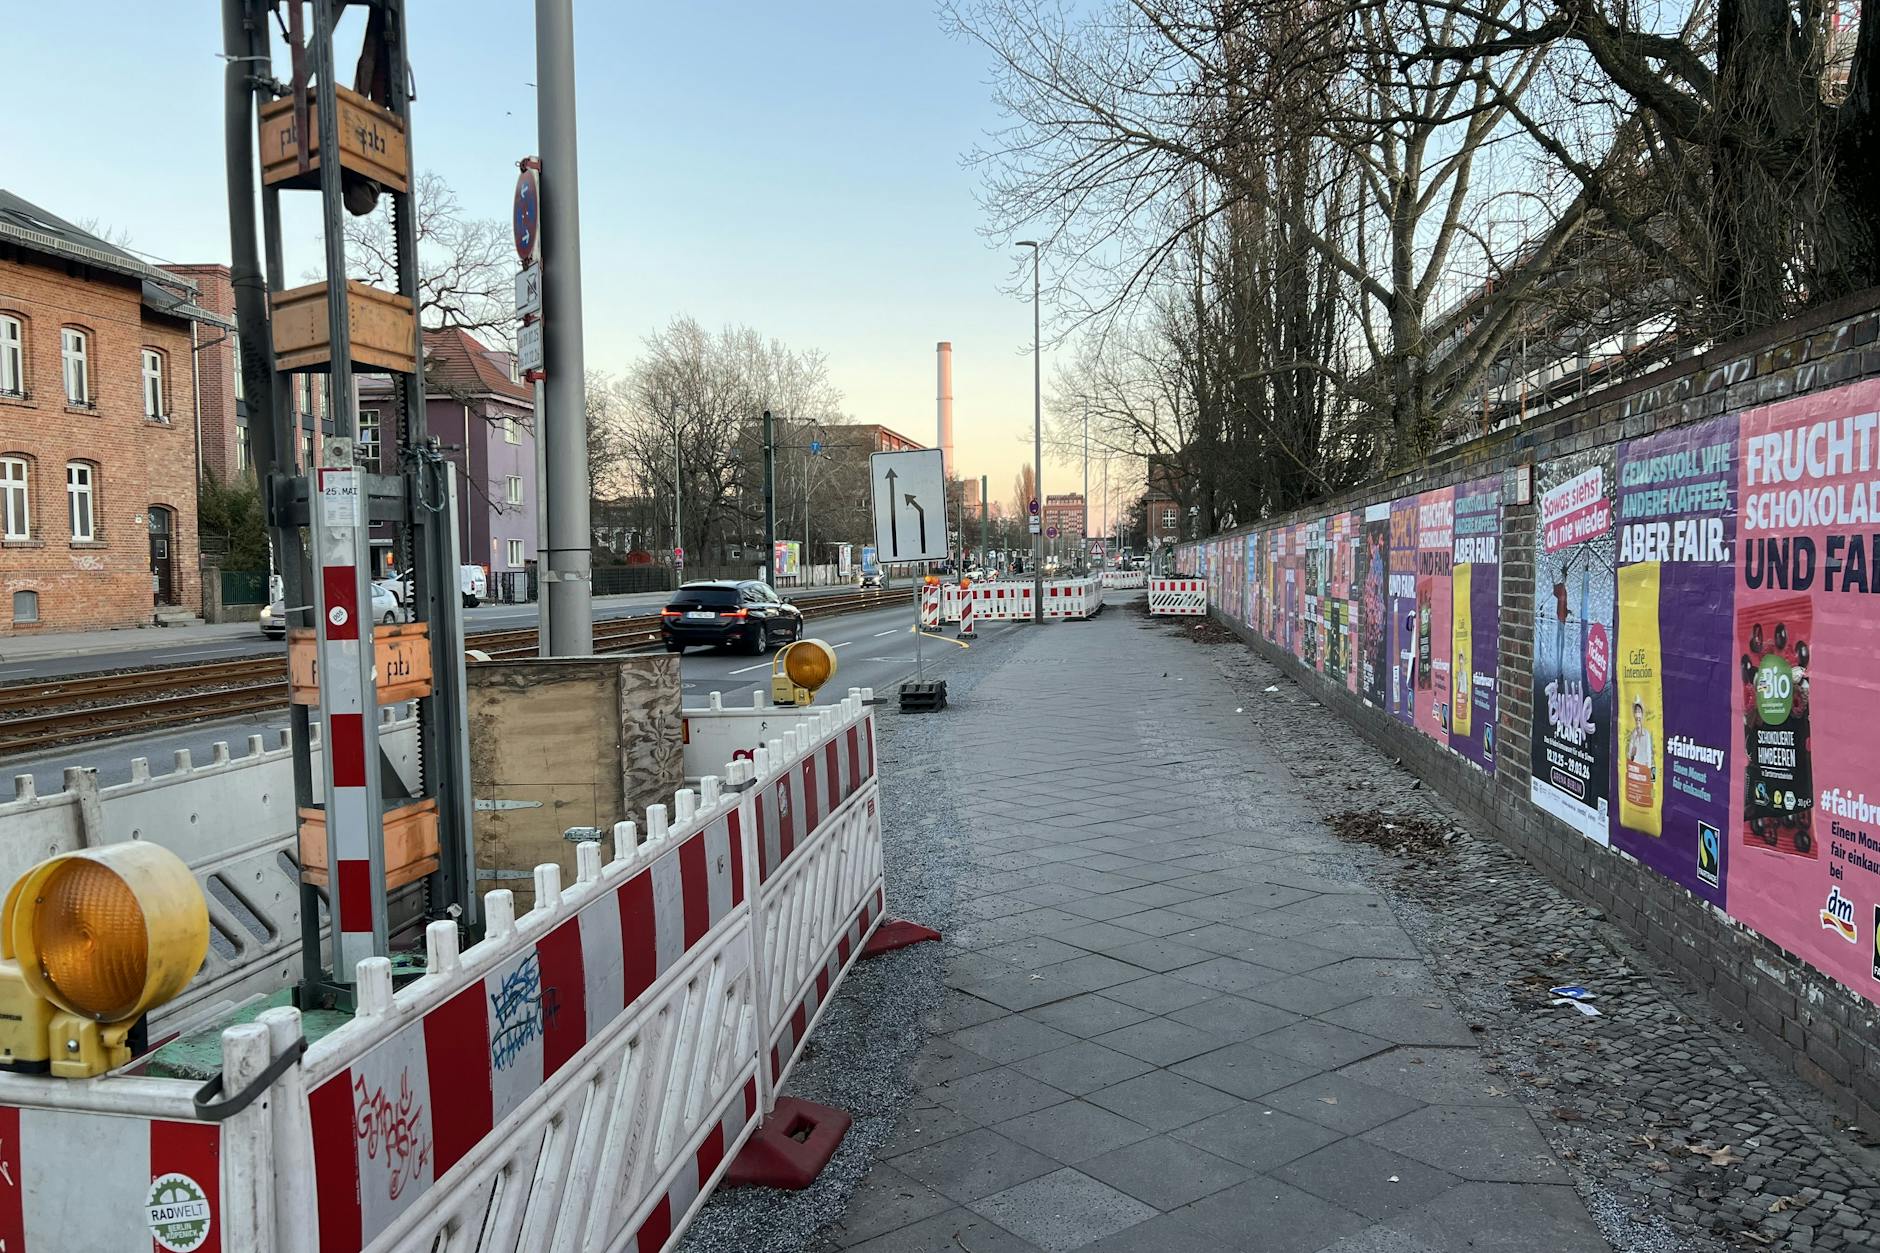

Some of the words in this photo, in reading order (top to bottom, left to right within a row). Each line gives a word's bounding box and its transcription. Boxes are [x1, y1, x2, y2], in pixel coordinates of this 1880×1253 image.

[1622, 449, 1700, 488] GENUSSVOLL
[1701, 442, 1731, 475] WIE
[1746, 412, 1880, 487] FRUCHT
[1544, 491, 1570, 519] Sowas
[1571, 473, 1600, 506] siehst
[1621, 488, 1668, 519] ANDERE
[1546, 524, 1558, 548] du
[1560, 517, 1573, 544] nie
[1574, 505, 1608, 538] wieder
[1619, 521, 1671, 563] ABER
[1672, 517, 1730, 562] FAIR.
[1419, 551, 1434, 576] UND
[1453, 537, 1476, 563] ABER
[1476, 537, 1498, 564] FAIR.
[1744, 536, 1817, 592] UND
[1588, 640, 1607, 672] Tickets
[1624, 664, 1653, 679] Intención
[1629, 648, 1646, 665] Café
[1763, 666, 1791, 700] Bio
[1667, 735, 1724, 771] #fairbruary
[1831, 821, 1856, 843] Einen
[1858, 830, 1880, 854] Mon
[1829, 861, 1843, 881] bei
[1830, 840, 1847, 860] fair
[1847, 848, 1880, 876] einkau
[1828, 889, 1852, 923] dm
[151, 1203, 204, 1221] RADWELT
